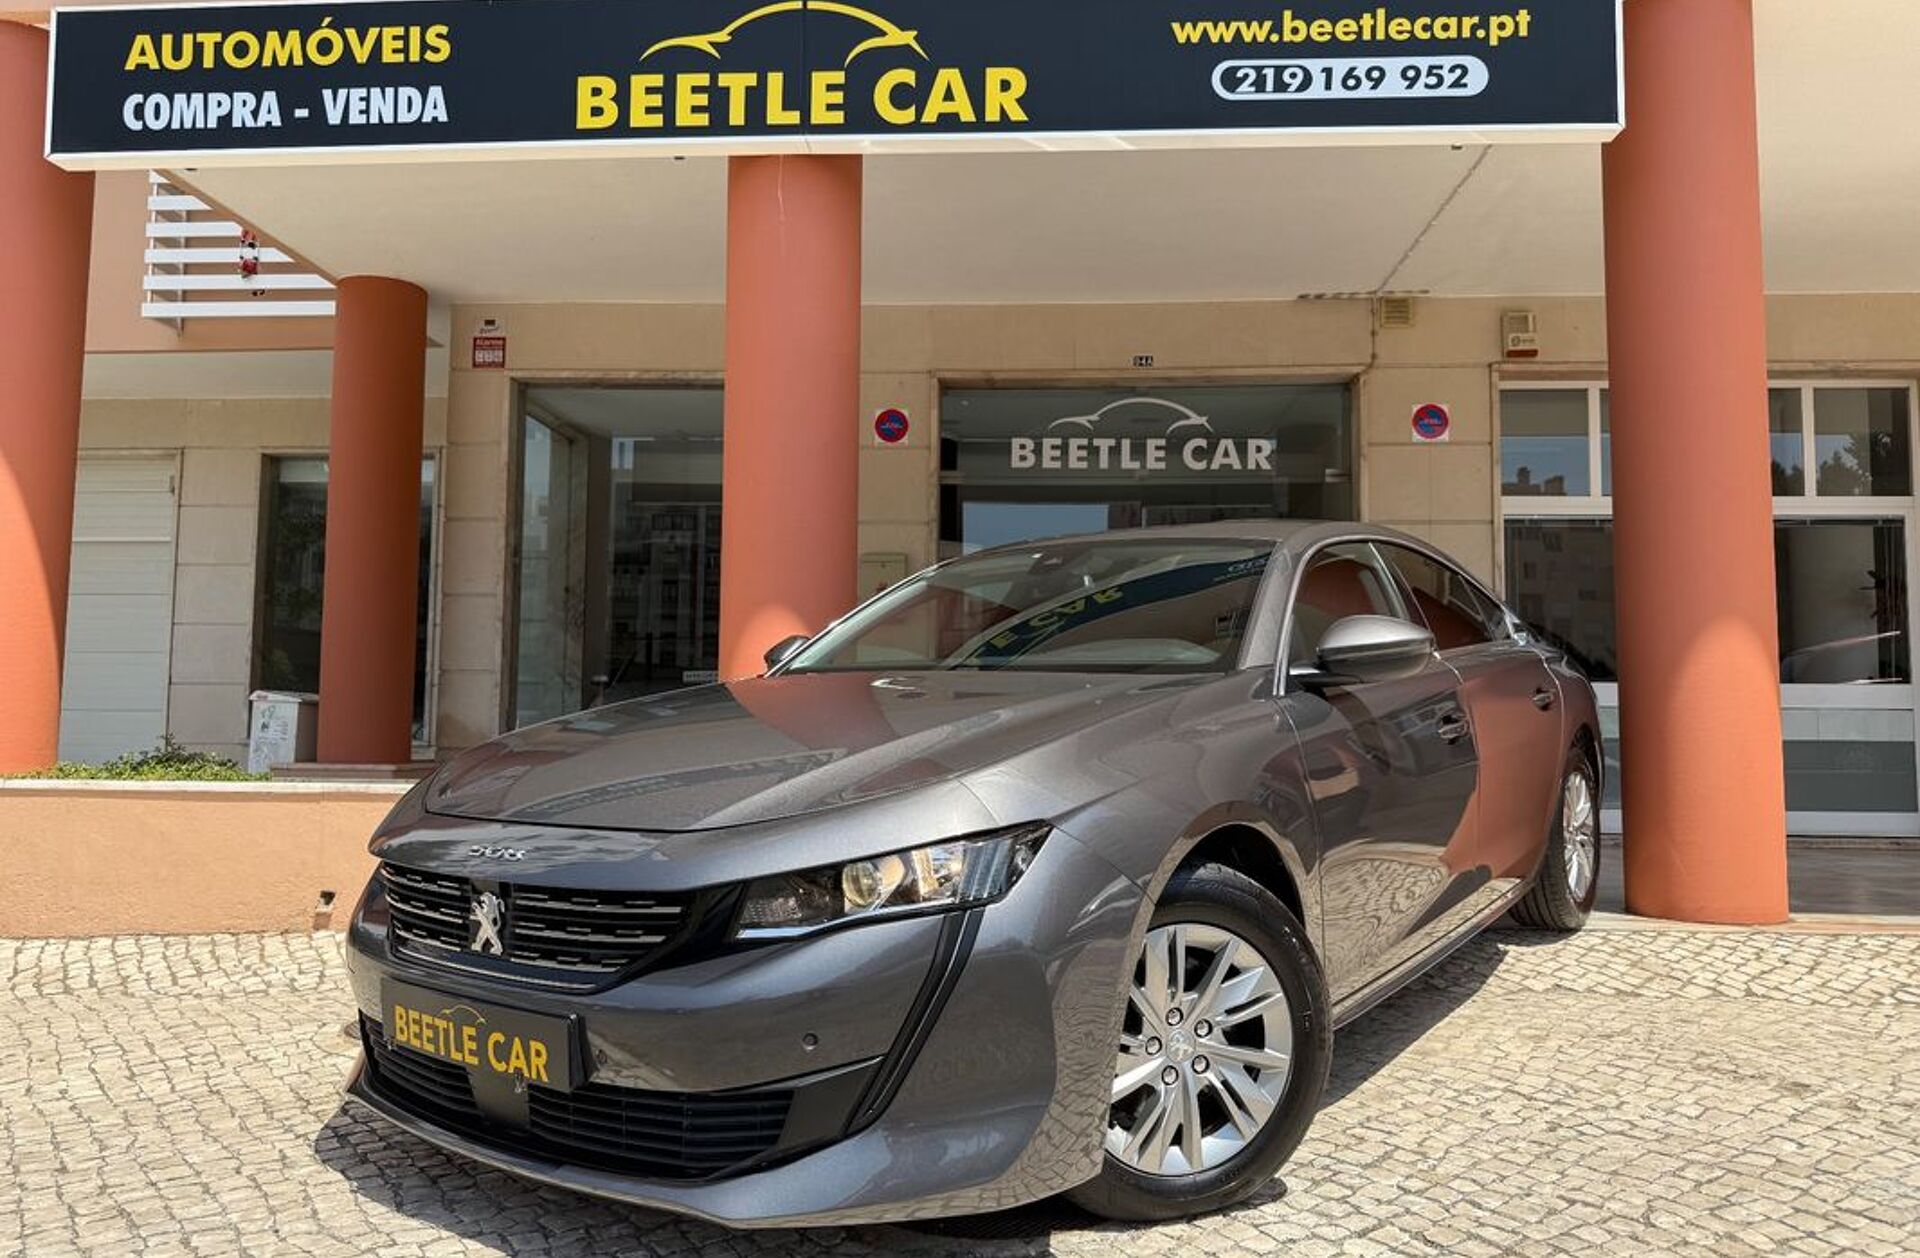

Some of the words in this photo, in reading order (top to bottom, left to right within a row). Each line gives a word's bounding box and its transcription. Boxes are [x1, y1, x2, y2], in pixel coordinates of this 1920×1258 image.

[125, 17, 451, 71] AUTOMÓVEIS
[1171, 8, 1531, 46] www.beetlecar.pt
[575, 70, 845, 130] BEETLE
[873, 67, 1028, 125] CAR
[1234, 66, 1305, 93] 219
[1320, 65, 1386, 91] 169
[1400, 63, 1469, 90] 952
[122, 90, 282, 131] COMPRA
[321, 85, 449, 125] VENDA
[1011, 438, 1167, 469] BEETLE
[1183, 438, 1274, 471] CAR
[394, 1004, 480, 1066] BEETLE
[487, 1031, 549, 1083] CAR
